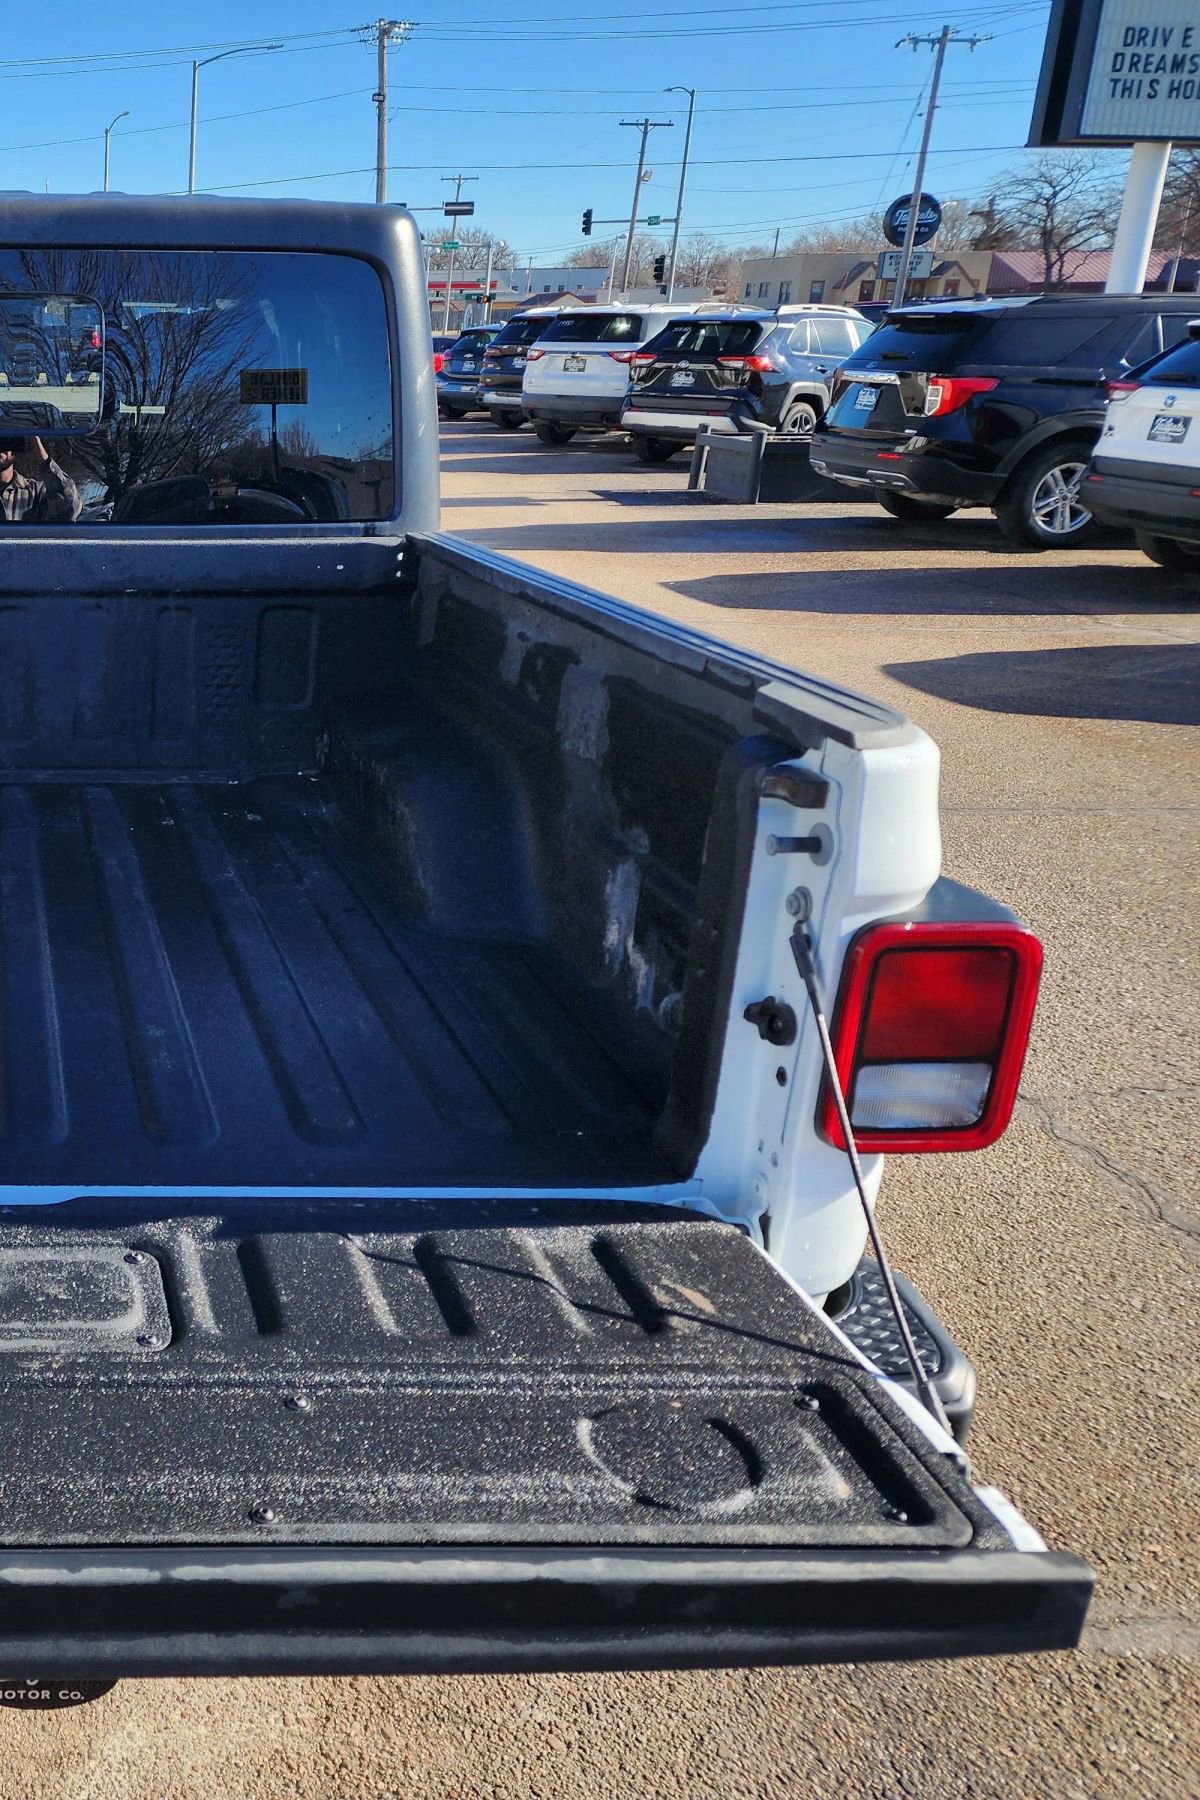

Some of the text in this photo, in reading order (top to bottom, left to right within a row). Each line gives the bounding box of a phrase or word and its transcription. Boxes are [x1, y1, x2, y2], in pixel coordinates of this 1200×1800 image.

[1123, 26, 1195, 48] DRIVE
[1111, 52, 1200, 74] DREAMS
[1109, 78, 1160, 99] THIS
